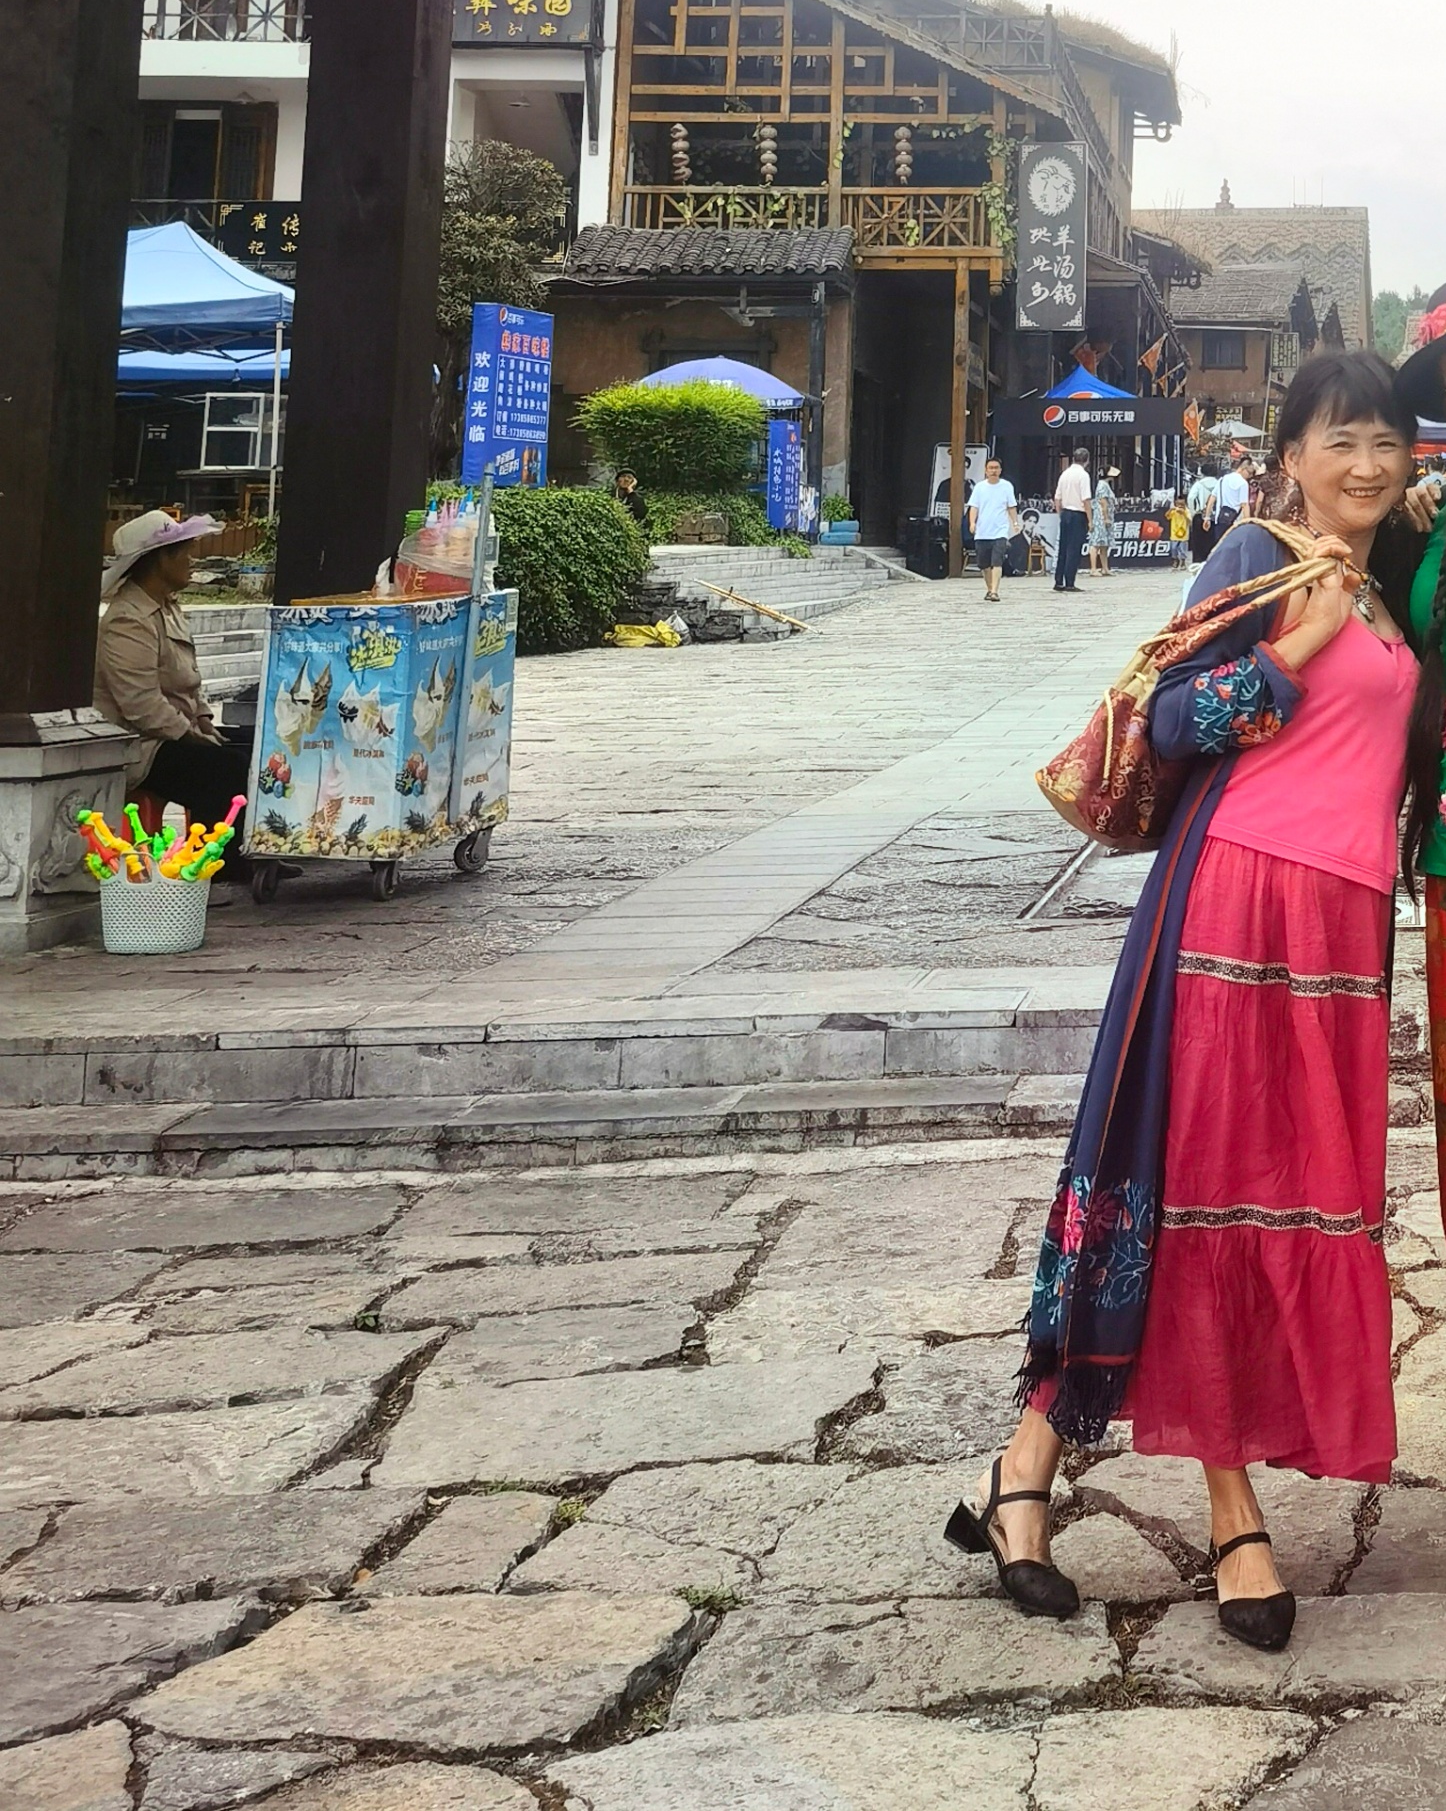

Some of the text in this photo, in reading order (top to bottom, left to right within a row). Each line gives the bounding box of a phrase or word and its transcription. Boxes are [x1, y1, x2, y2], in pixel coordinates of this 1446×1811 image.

[1049, 224, 1077, 307] 羊汤锅
[468, 351, 491, 443] 欢迎光临
[1068, 410, 1135, 423] 百事可乐无糖
